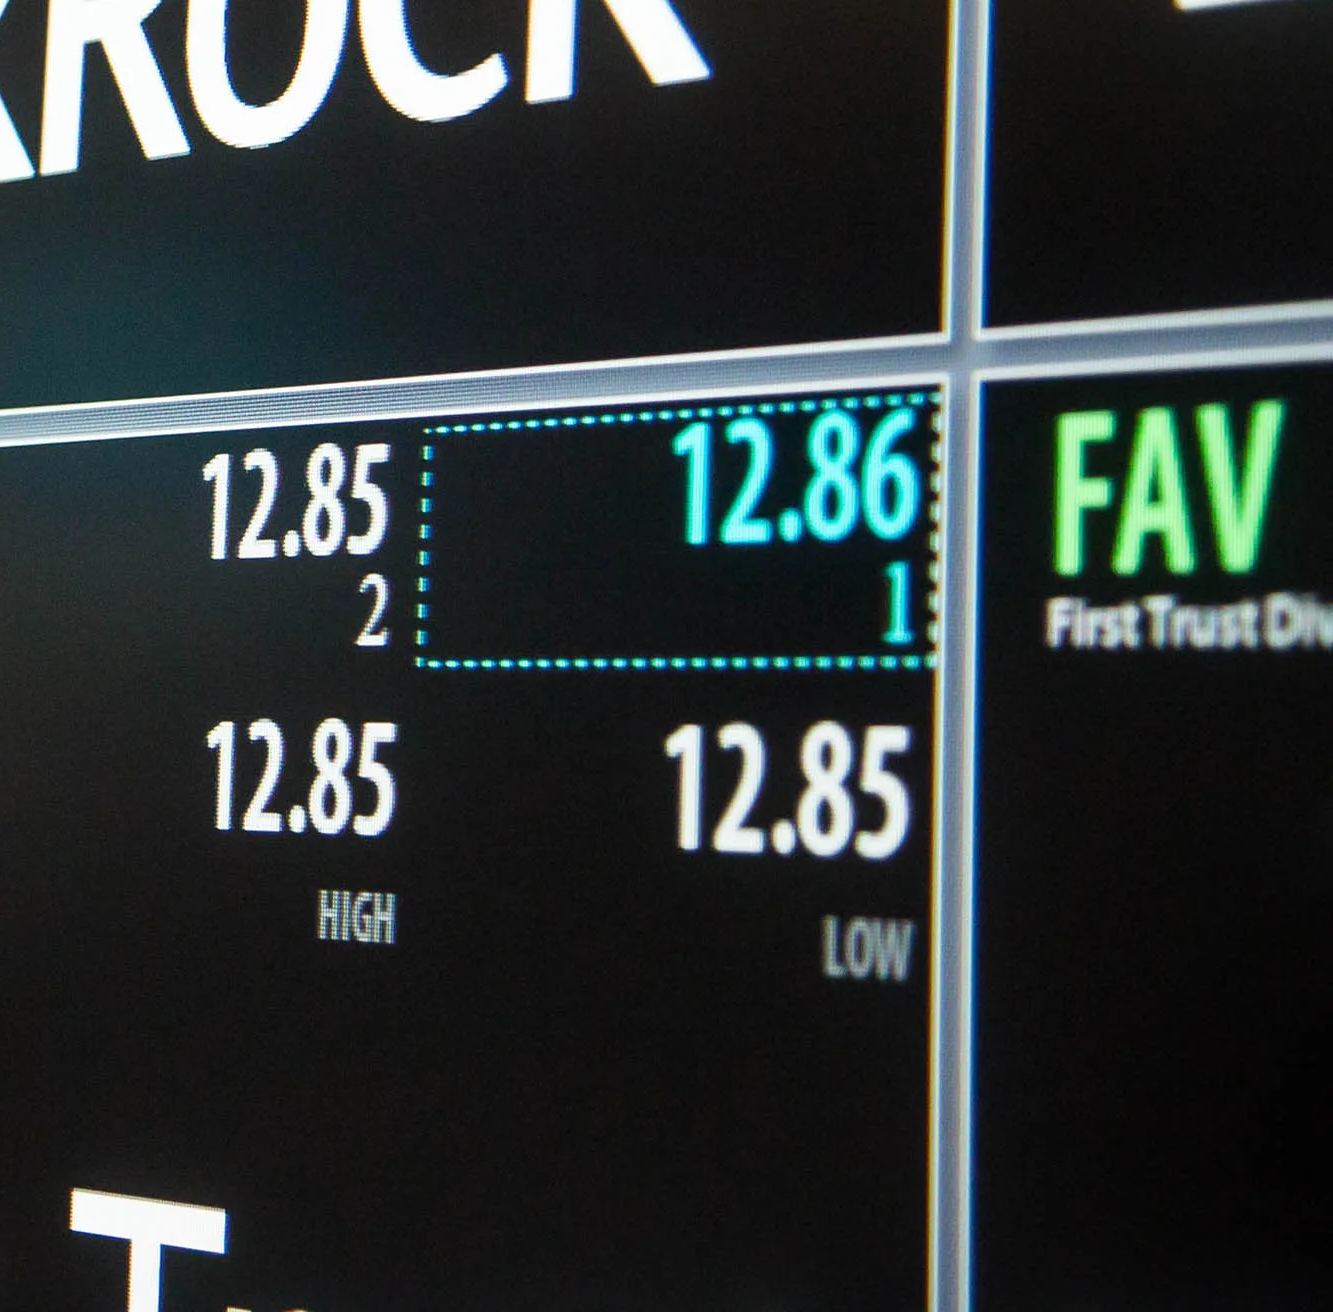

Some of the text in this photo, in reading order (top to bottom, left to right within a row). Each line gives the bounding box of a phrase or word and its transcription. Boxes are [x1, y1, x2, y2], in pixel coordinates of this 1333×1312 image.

[201, 442, 392, 560] 12.85
[671, 408, 921, 546] 12.86
[1054, 399, 1286, 577] FAV
[354, 572, 390, 647] 2
[883, 561, 914, 645] 1
[1044, 595, 1139, 649] First
[1142, 592, 1259, 649] Trust
[206, 717, 398, 837] 12.85
[664, 720, 912, 860] 12.85
[317, 888, 397, 945] HIGH
[821, 916, 916, 982] LOW
